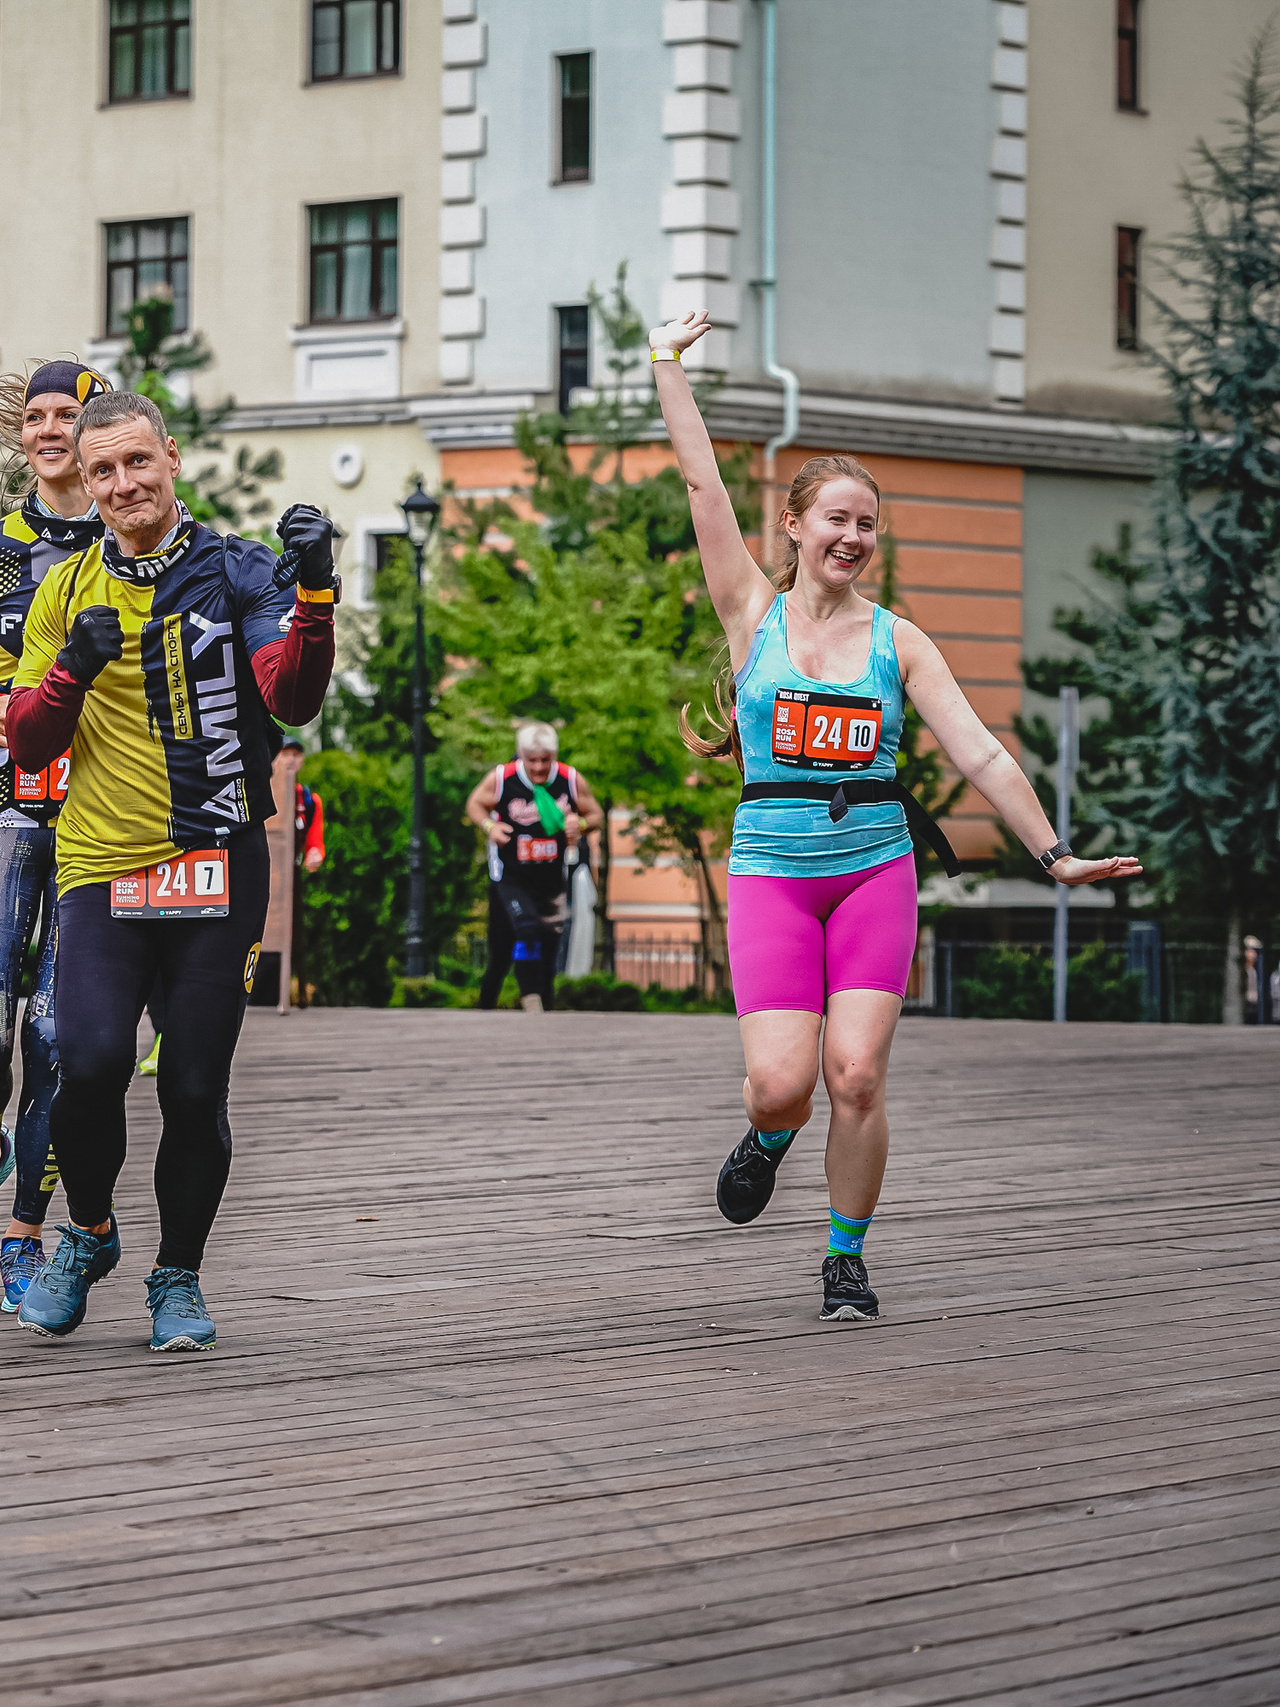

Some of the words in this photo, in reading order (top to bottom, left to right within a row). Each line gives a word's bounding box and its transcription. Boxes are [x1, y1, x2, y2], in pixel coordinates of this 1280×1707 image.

[1, 614, 23, 635] F
[168, 619, 179, 667] СПОРТЕ
[171, 669, 182, 688] НА
[780, 690, 792, 699] ROSA
[793, 692, 809, 702] QUEST
[175, 691, 187, 735] СЕМЬЯ
[189, 611, 243, 835] AMILY
[776, 727, 796, 736] ROSA
[776, 734, 791, 742] RUN
[812, 715, 842, 750] 24
[854, 725, 871, 747] 10
[19, 773, 41, 781] ROSA
[57, 757, 70, 790] 2
[235, 778, 243, 799] 2020
[156, 862, 188, 897] 24
[204, 867, 213, 890] 7
